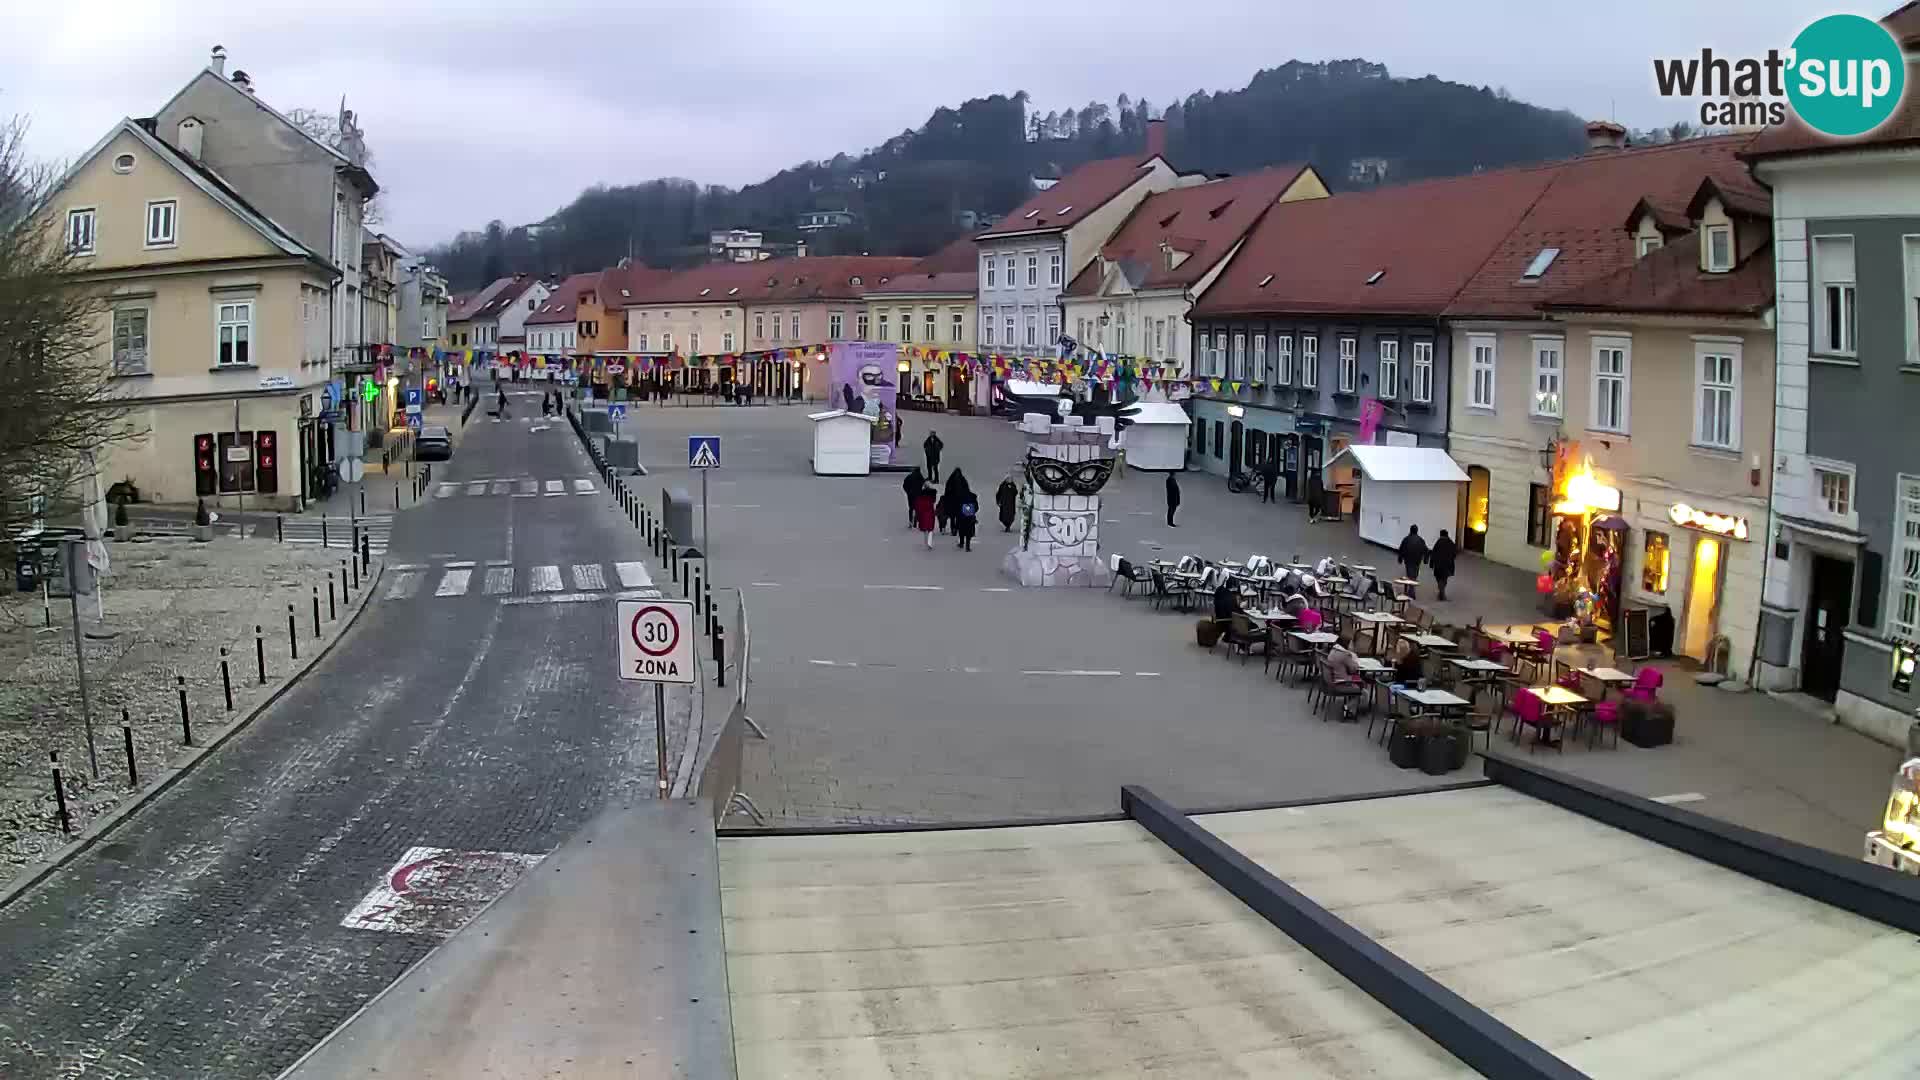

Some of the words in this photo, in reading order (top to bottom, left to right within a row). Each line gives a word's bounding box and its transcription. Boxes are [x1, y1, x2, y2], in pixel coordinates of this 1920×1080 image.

[410, 391, 417, 402] P
[1048, 516, 1088, 545] 200
[644, 622, 668, 643] 30
[634, 659, 679, 676] ZONA
